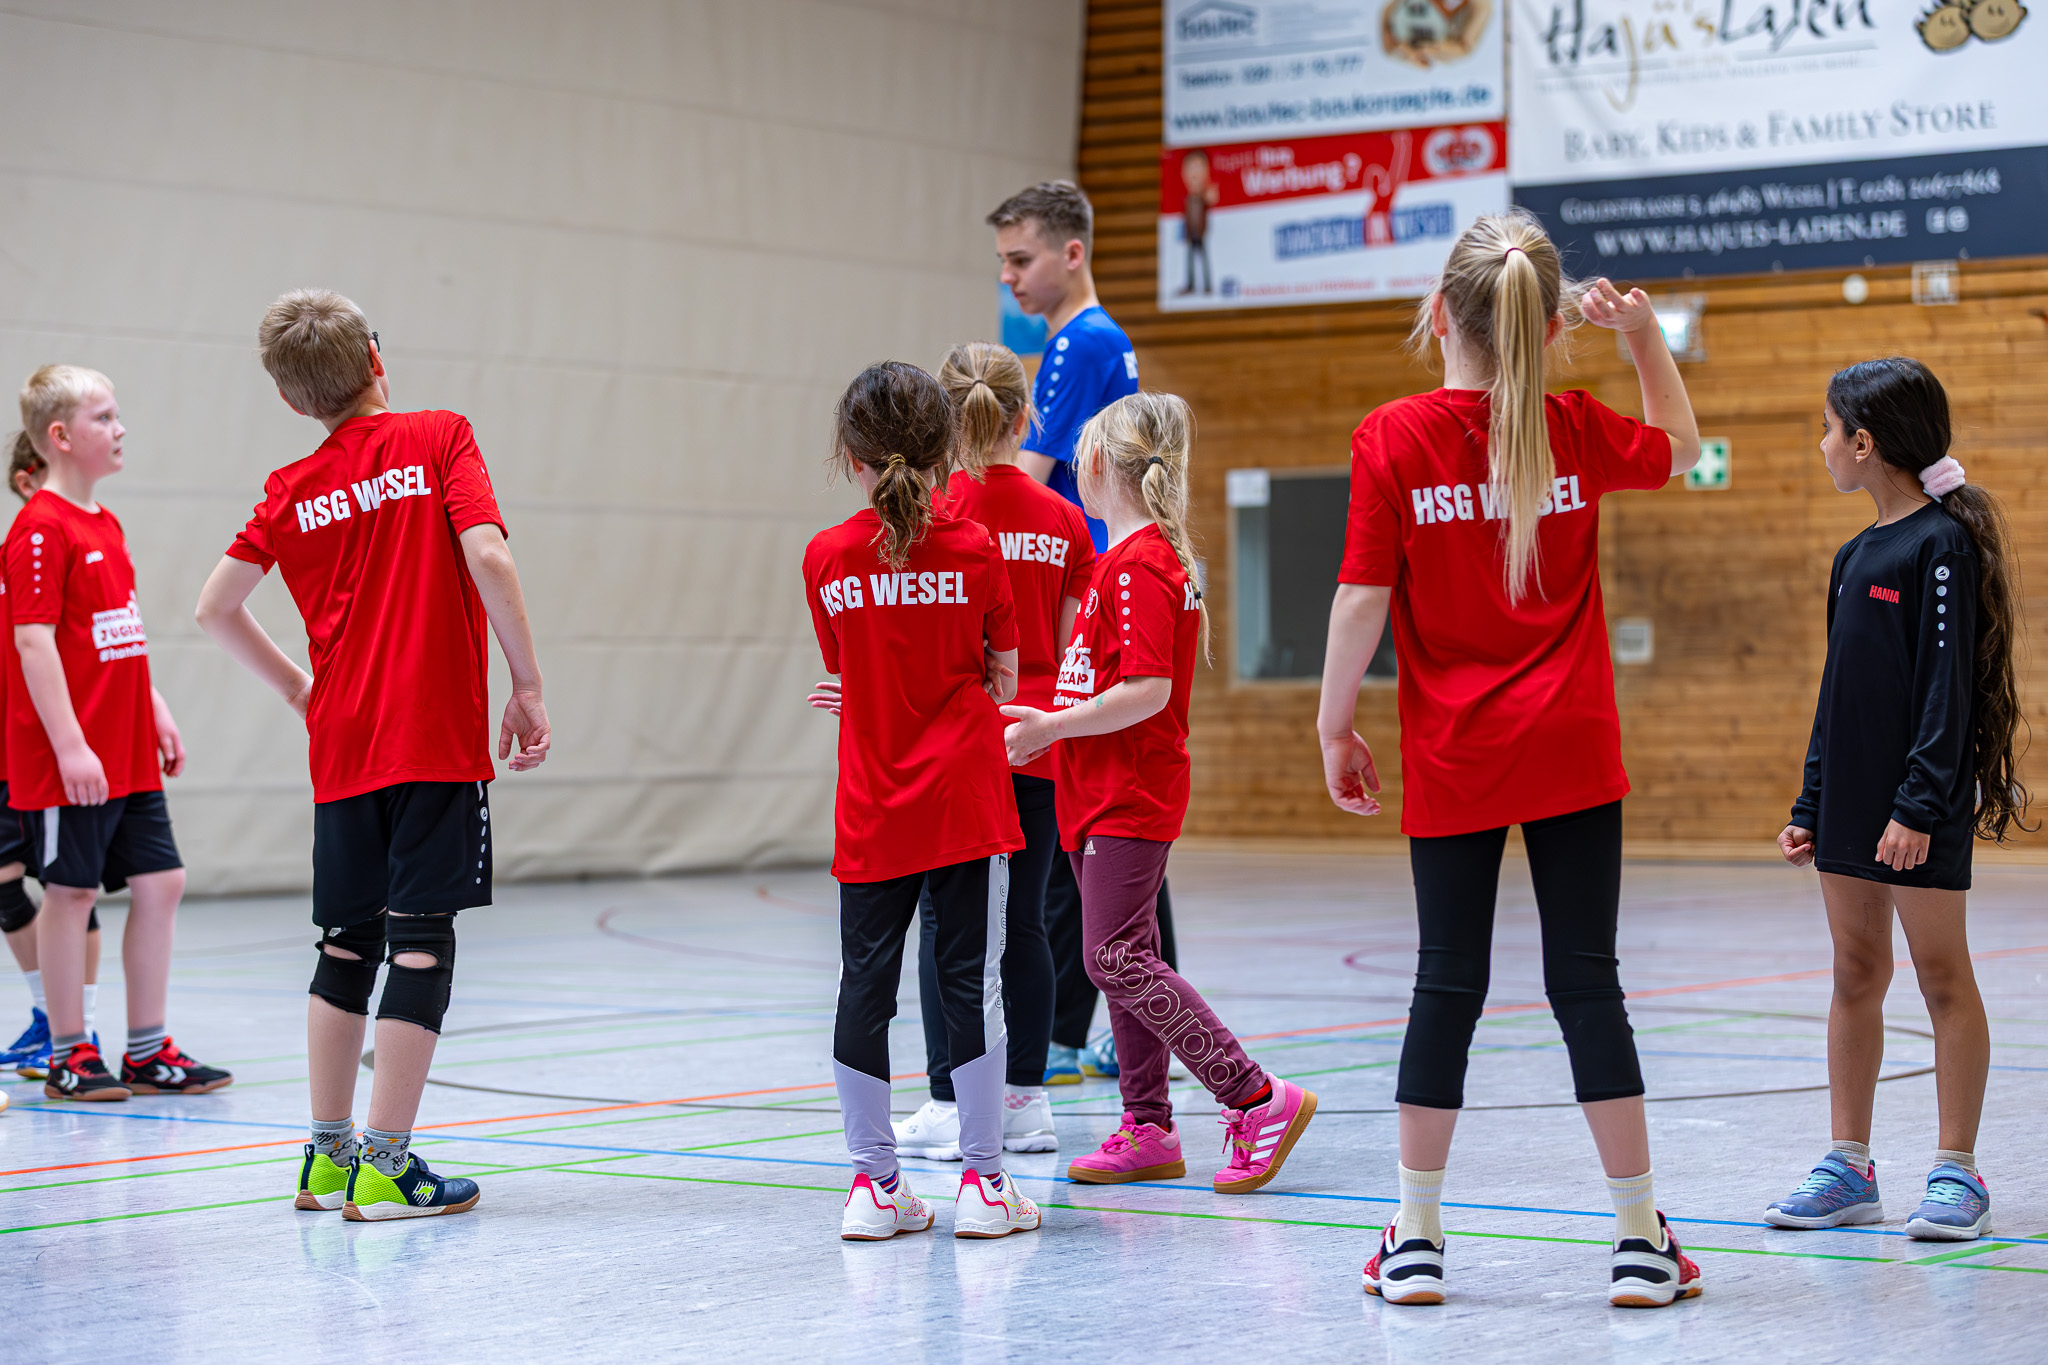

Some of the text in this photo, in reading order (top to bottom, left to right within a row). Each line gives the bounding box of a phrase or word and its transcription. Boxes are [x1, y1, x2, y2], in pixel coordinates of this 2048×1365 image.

[295, 489, 351, 533] HSG
[1411, 483, 1475, 525] HSG
[998, 532, 1070, 568] WESEL
[820, 571, 969, 617] HSG WESEL
[1868, 584, 1900, 604] HANIA
[1096, 939, 1240, 1096] adidas
